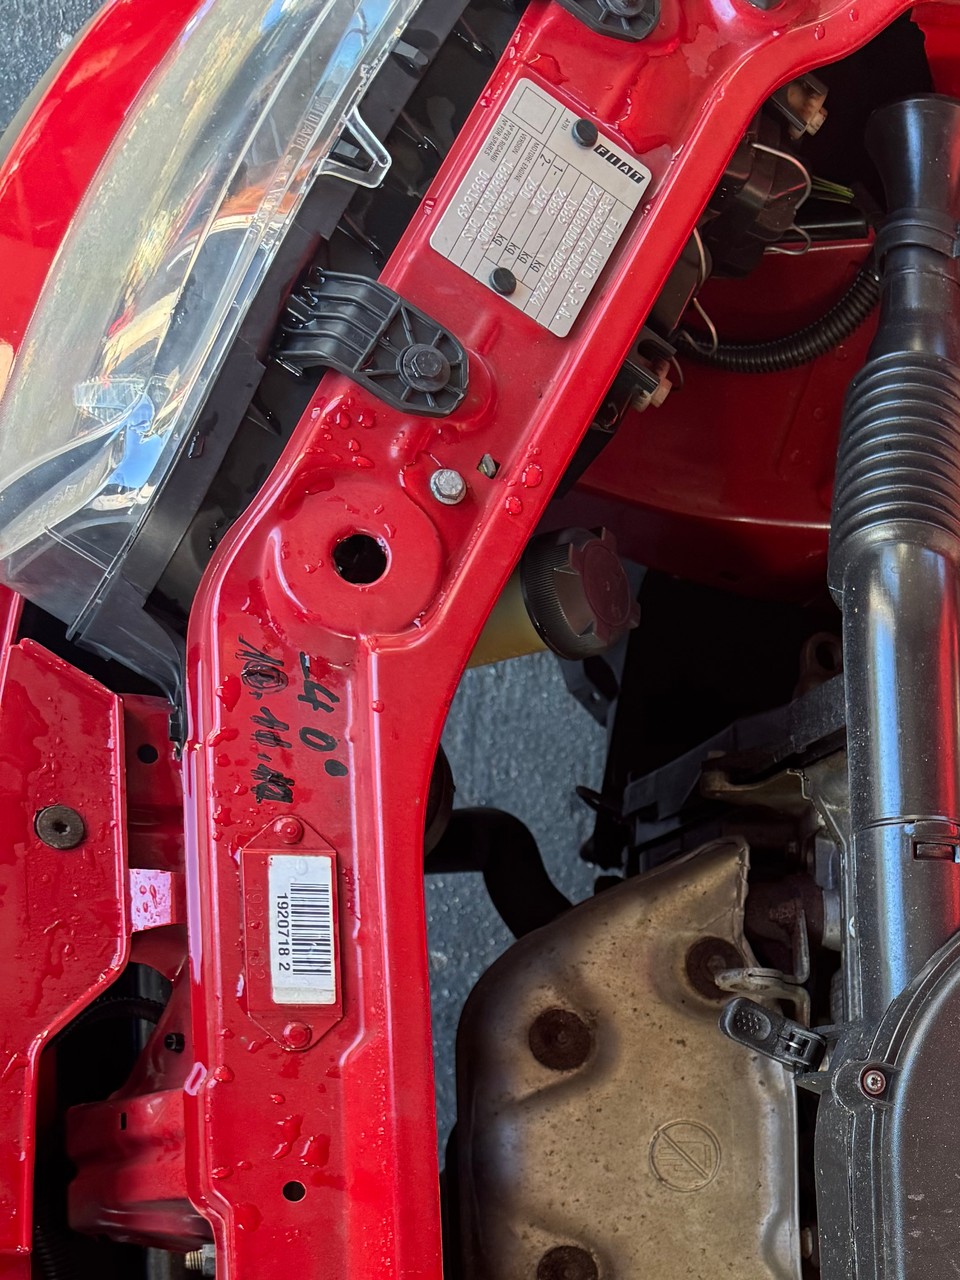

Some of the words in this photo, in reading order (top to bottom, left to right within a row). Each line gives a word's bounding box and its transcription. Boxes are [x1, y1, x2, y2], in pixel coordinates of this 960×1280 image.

[494, 124, 504, 137] FOR
[500, 128, 511, 142] PER
[483, 134, 499, 157] SPARES
[488, 139, 506, 163] RICAMBI
[510, 131, 528, 156] VERSION
[594, 144, 646, 184] FIAT
[492, 232, 508, 249] kg
[596, 215, 623, 251] FIAT
[504, 240, 520, 257] kg
[517, 249, 532, 266] kg
[529, 257, 544, 274] kg
[580, 248, 605, 280] AUTO
[275, 892, 290, 956] 1920718
[278, 961, 291, 971] 2
